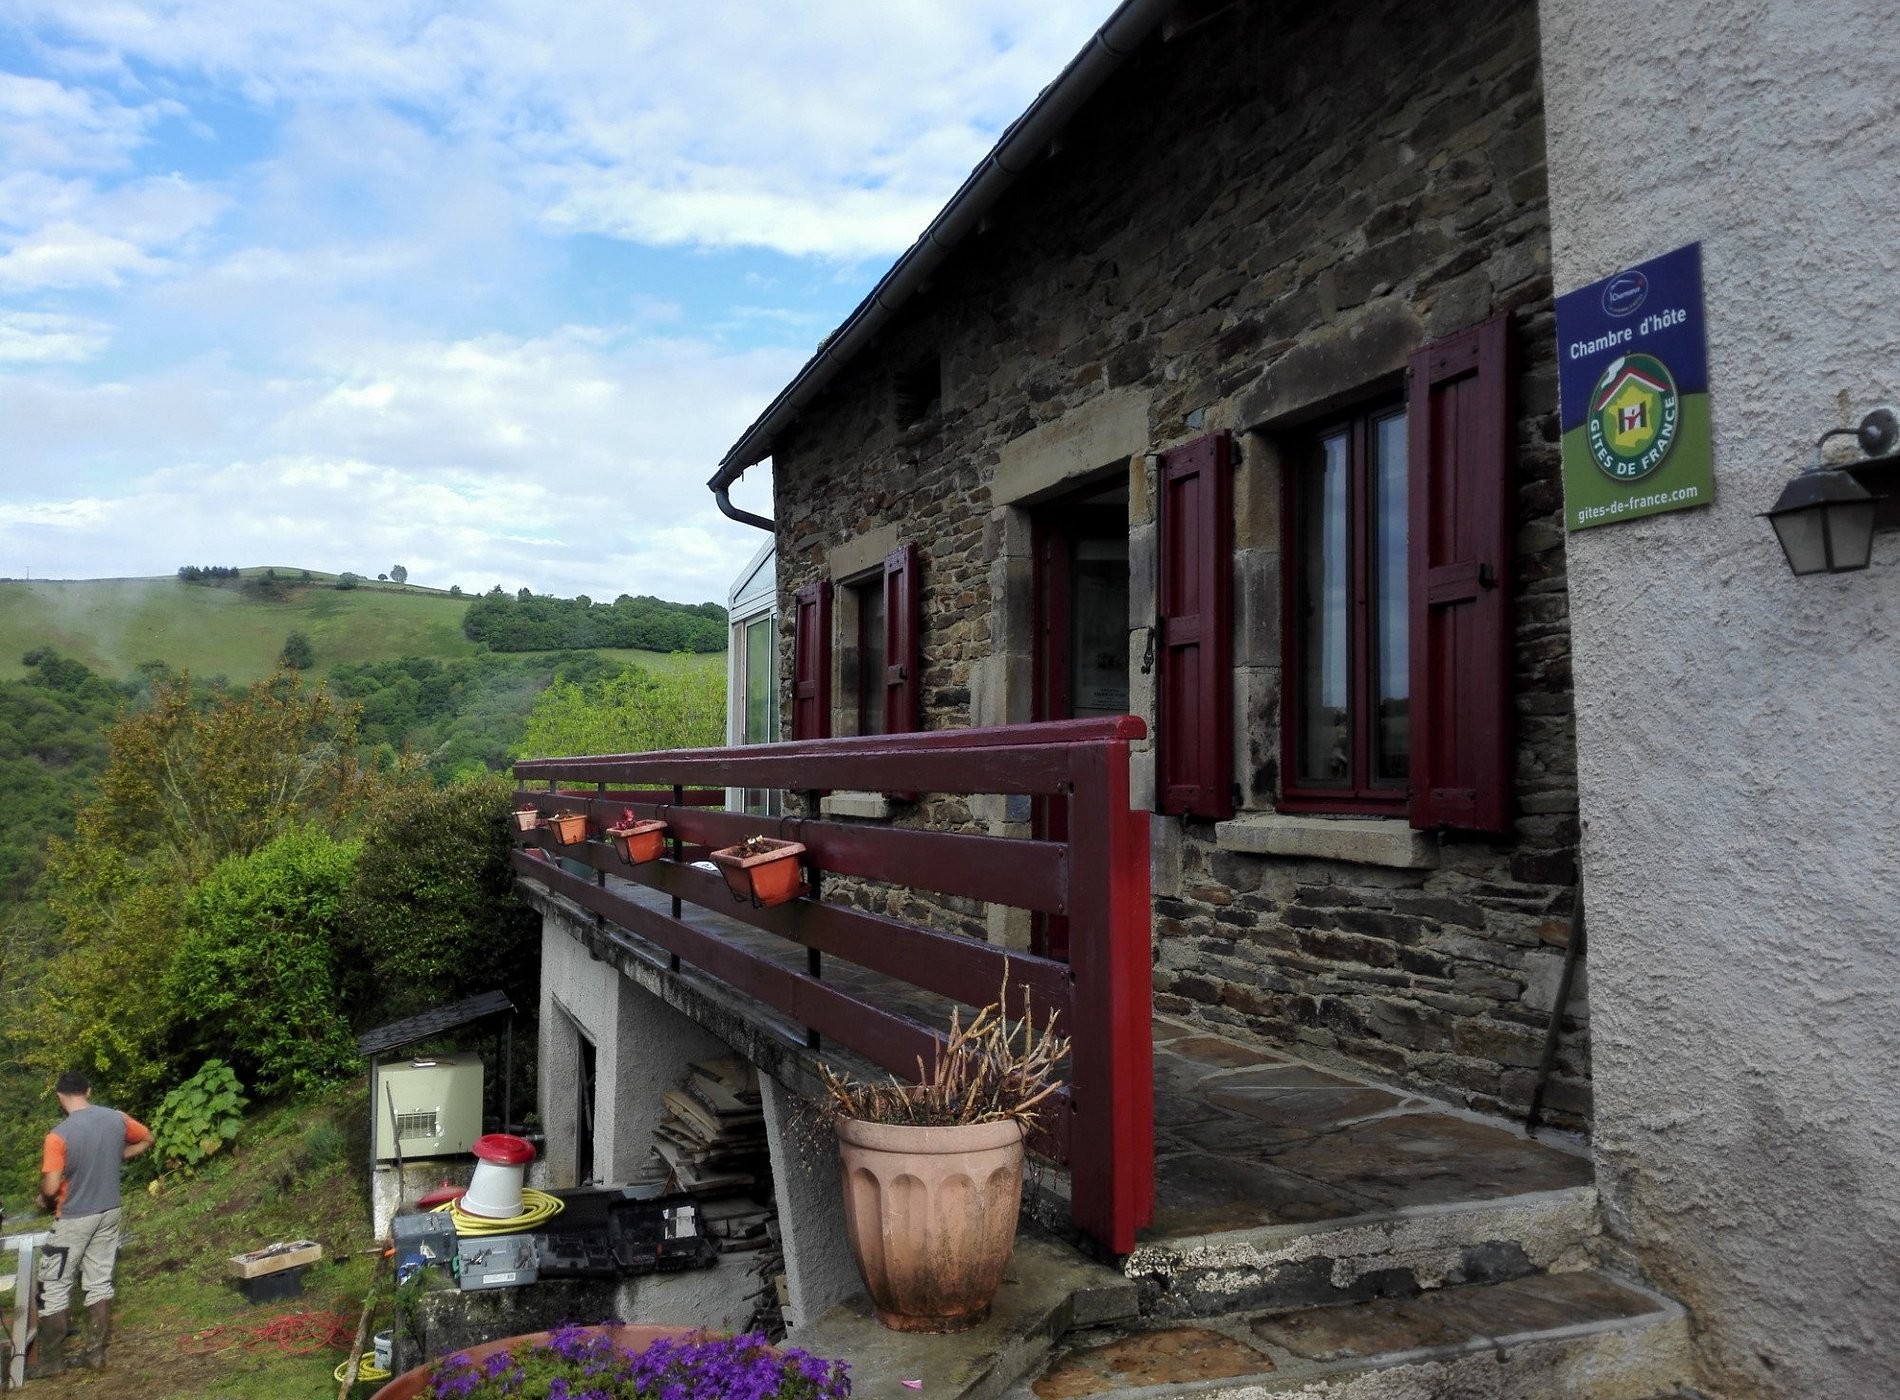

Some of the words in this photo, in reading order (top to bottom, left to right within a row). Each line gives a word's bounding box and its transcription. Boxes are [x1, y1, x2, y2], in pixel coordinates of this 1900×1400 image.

[1570, 328, 1633, 360] Chambre
[1640, 308, 1687, 336] d'hôte
[1616, 462, 1636, 475] DE
[1641, 396, 1675, 470] FRANCE
[1578, 485, 1698, 524] gites-de-france.com
